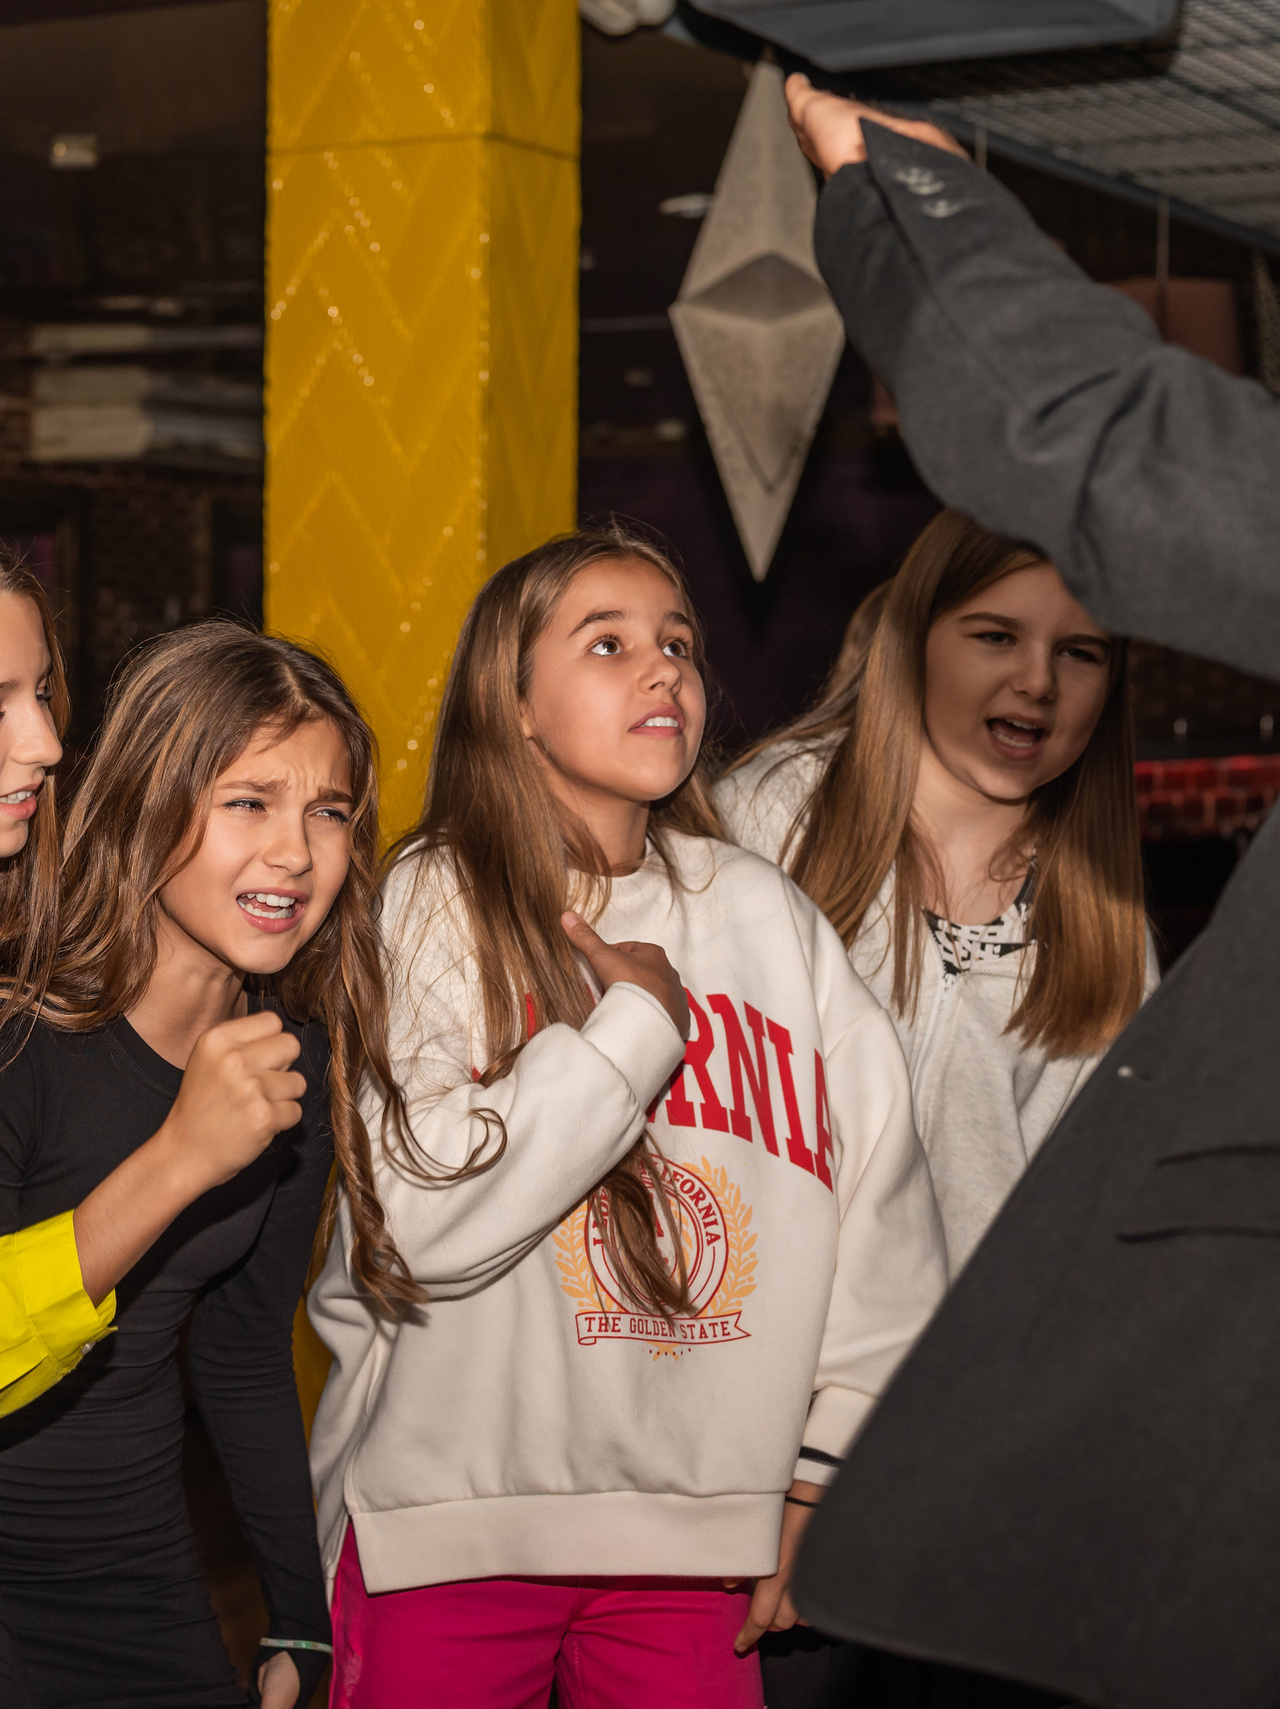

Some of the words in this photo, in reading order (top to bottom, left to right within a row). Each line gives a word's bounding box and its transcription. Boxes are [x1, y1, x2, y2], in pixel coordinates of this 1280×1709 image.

[584, 1316, 621, 1333] THE
[629, 1317, 677, 1338] GOLDEN
[680, 1320, 731, 1340] STATE
